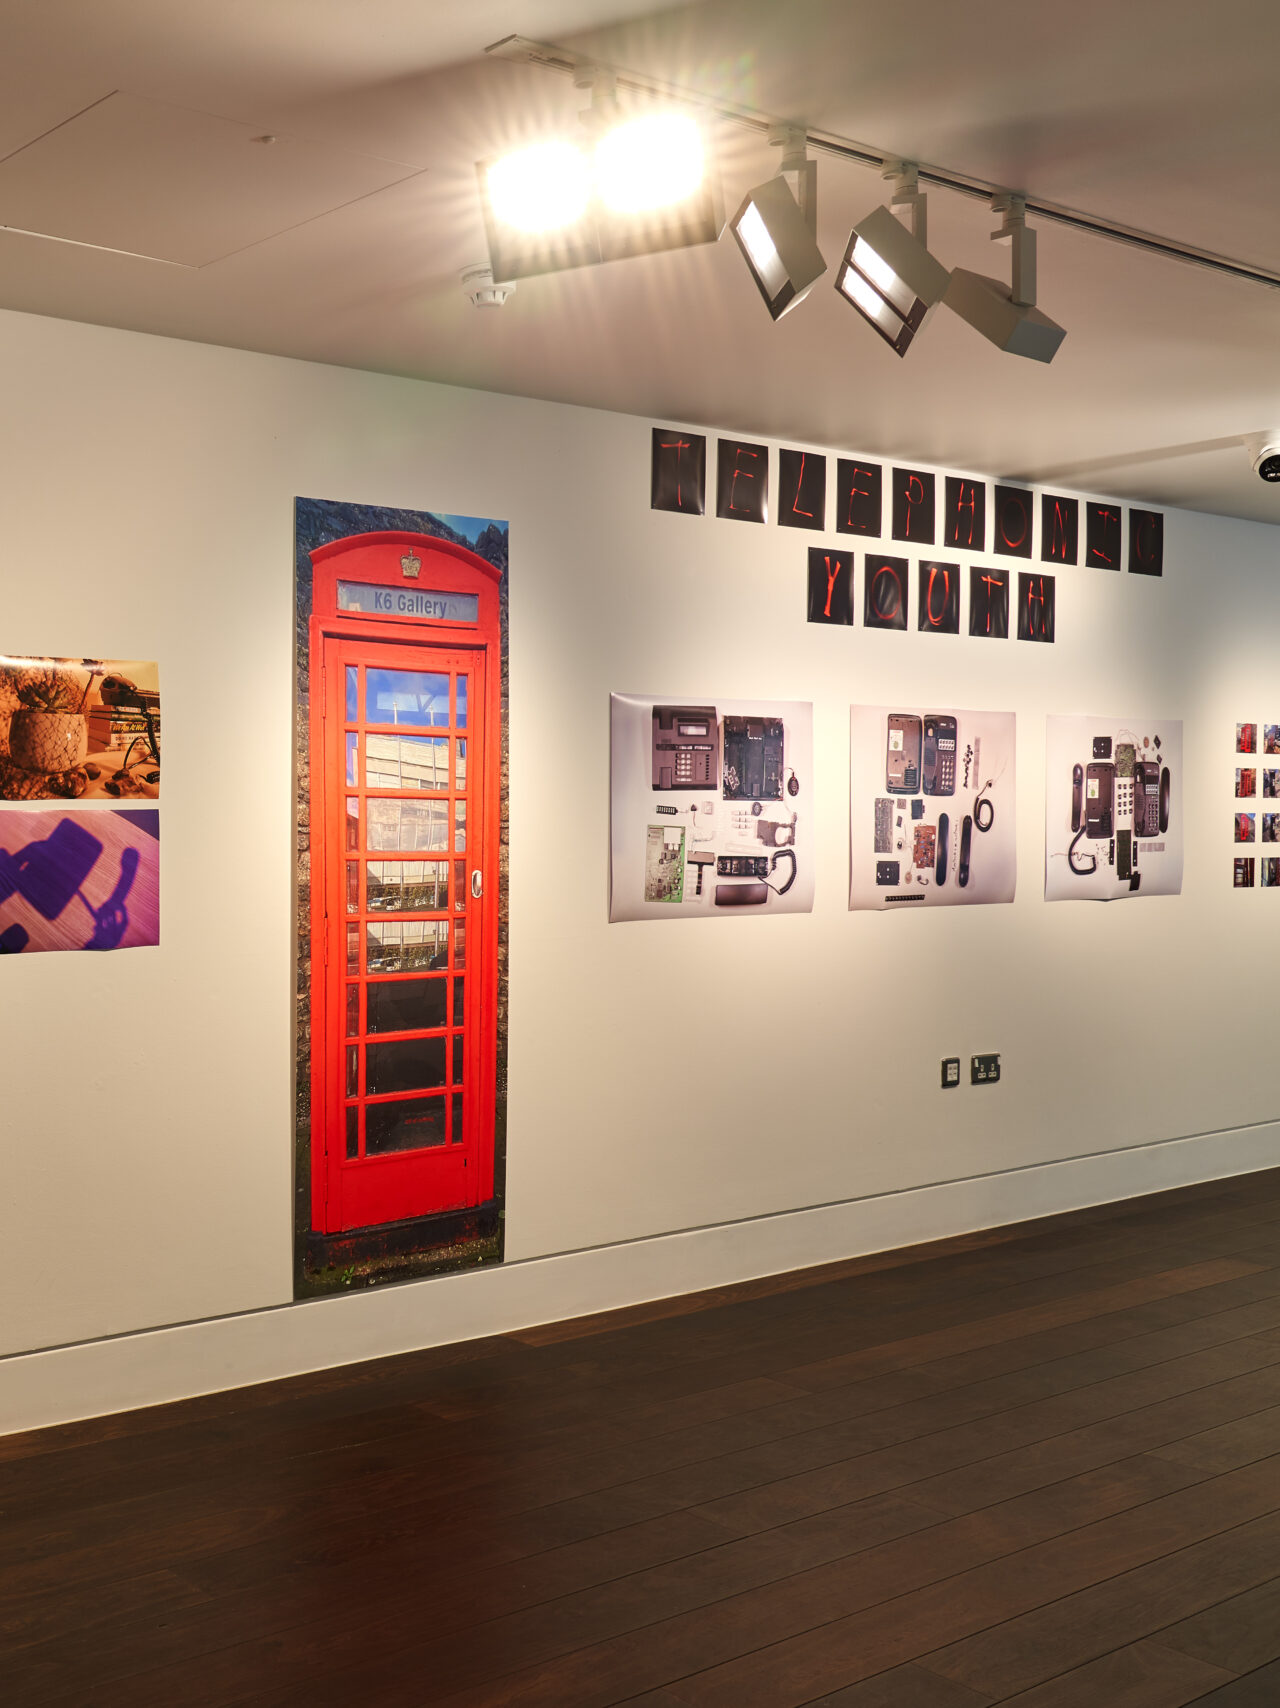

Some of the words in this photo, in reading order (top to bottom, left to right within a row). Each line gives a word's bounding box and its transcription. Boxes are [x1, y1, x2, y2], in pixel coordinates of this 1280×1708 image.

[660, 439, 1159, 563] TELEPHONIC
[374, 591, 393, 610] K6
[397, 594, 448, 619] Gallery
[822, 555, 1046, 636] YOUTH
